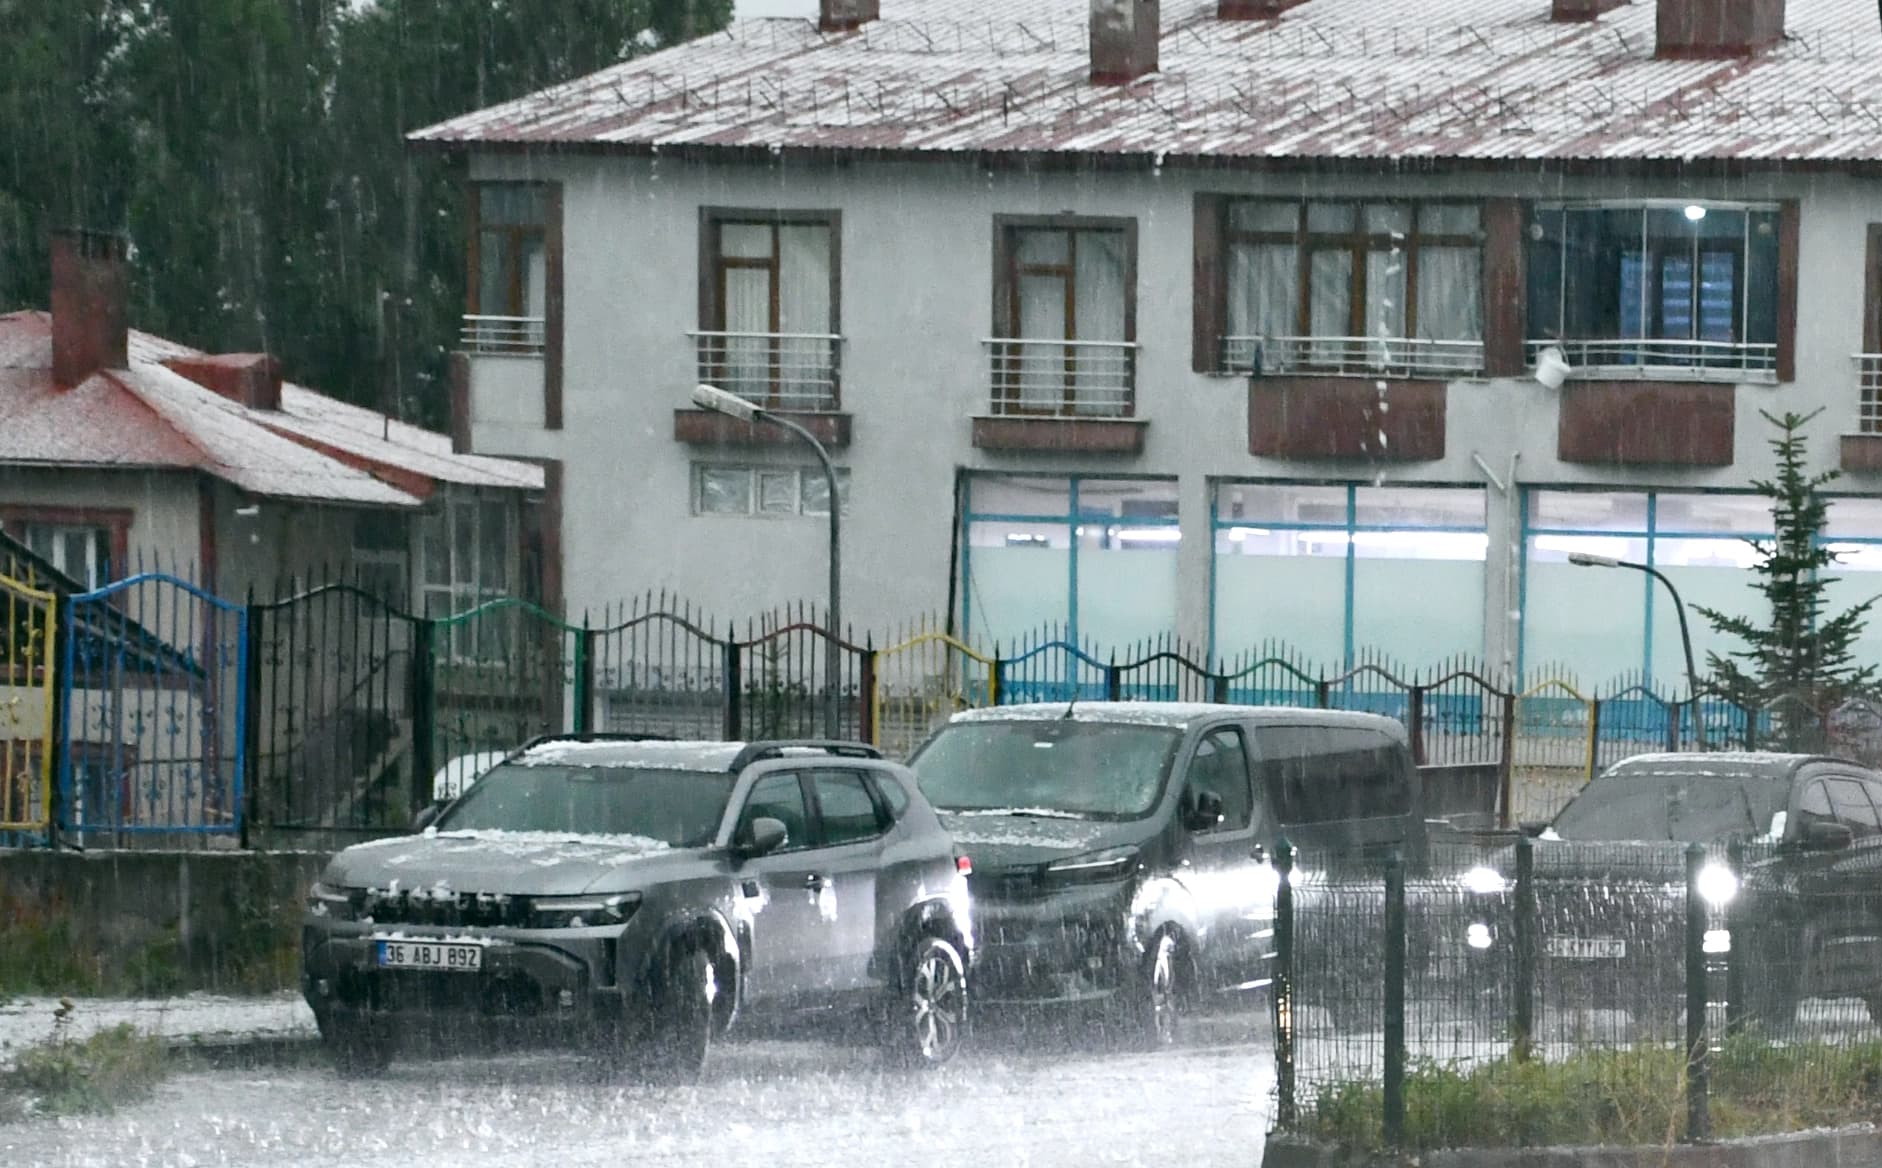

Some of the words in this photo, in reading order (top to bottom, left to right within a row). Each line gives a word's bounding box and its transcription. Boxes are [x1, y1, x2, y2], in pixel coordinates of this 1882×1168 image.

[387, 945, 404, 963] 36
[413, 947, 440, 964] ABJ
[448, 948, 476, 967] 892
